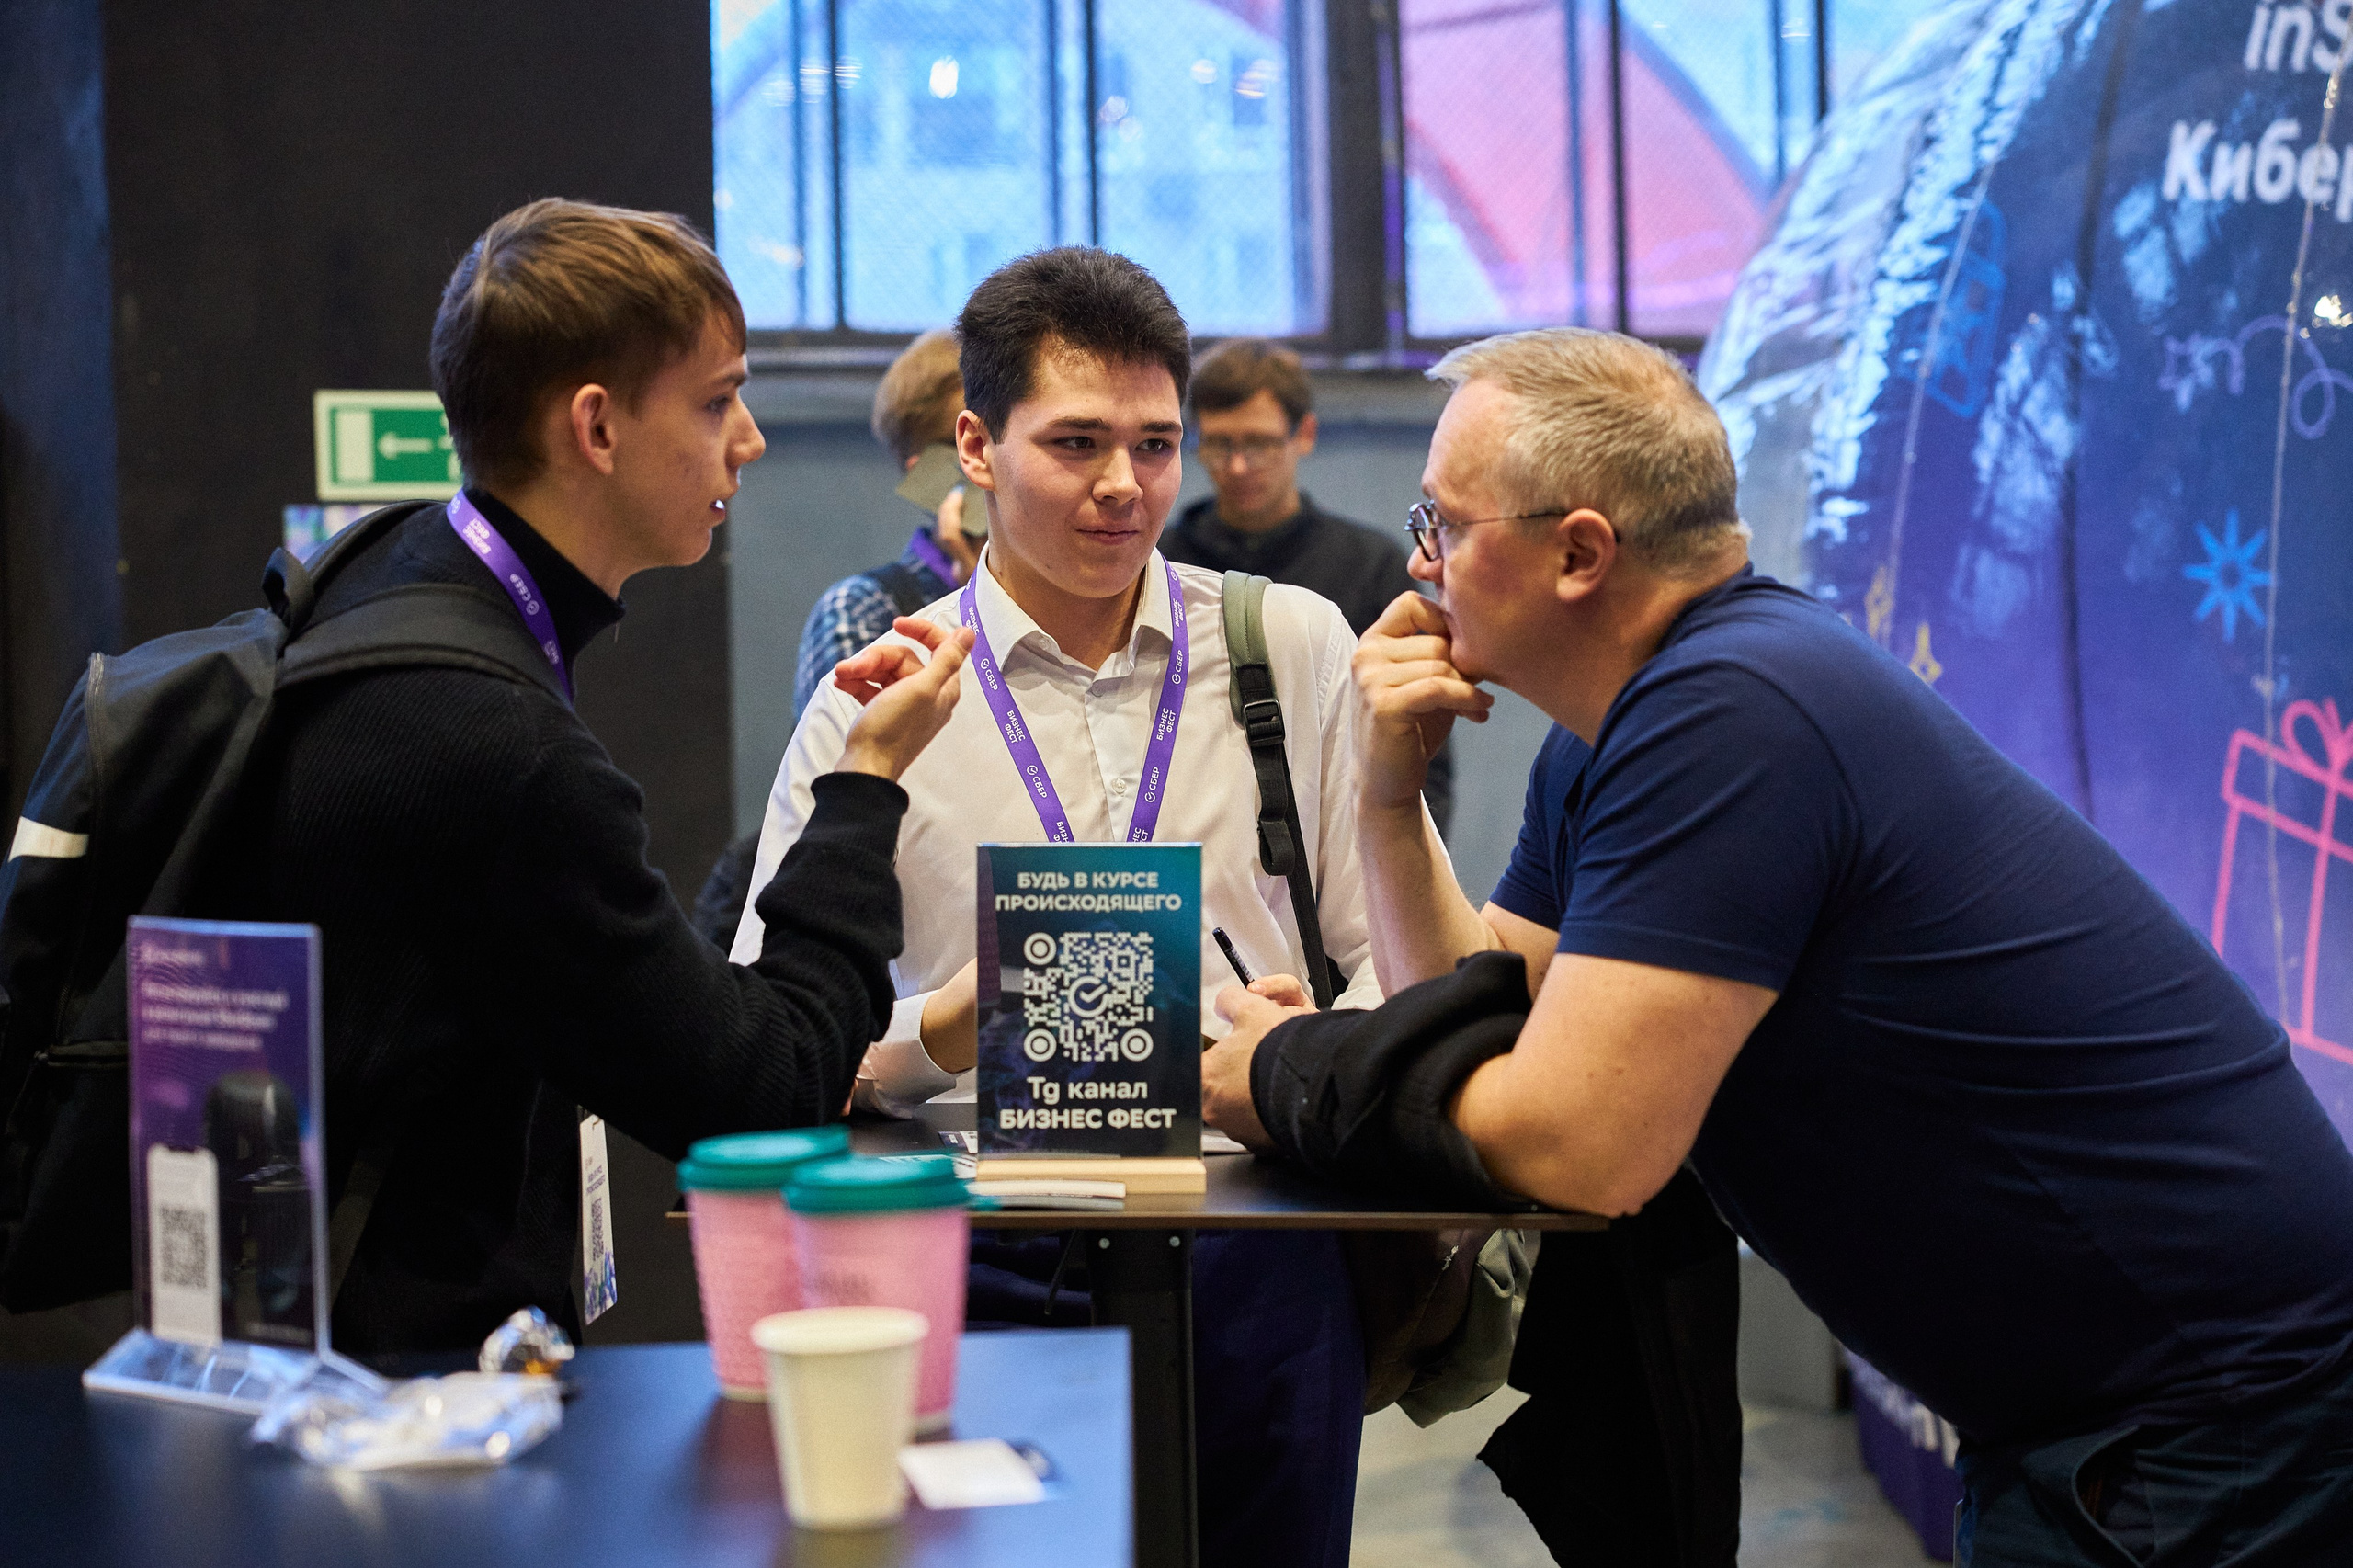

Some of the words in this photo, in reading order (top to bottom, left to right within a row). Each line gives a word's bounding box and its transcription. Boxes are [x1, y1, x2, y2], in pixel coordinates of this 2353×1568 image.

[968, 605, 980, 636] БИЗНЕС
[1176, 649, 1184, 673] СБЕР
[984, 668, 998, 691] СБЕР
[1004, 722, 1019, 744] ФЕСТ
[1006, 710, 1026, 742] БИЗНЕС
[1156, 707, 1170, 741] БИЗНЕС
[1165, 710, 1176, 733] ФЕСТ
[1031, 775, 1048, 799] СБЕР
[1148, 767, 1160, 791] СБЕР
[1056, 821, 1069, 842] БИЗН
[1017, 872, 1070, 890] БУДЬ
[1074, 872, 1088, 888] В
[1092, 872, 1158, 888] КУРСЕ
[995, 894, 1182, 912] ПРОИСХОДЯЩЕГО
[1027, 1077, 1061, 1104] Tg
[1067, 1081, 1148, 1099] канал
[999, 1109, 1103, 1129] БИЗНЕС
[1107, 1108, 1176, 1129] ФЕСТ
